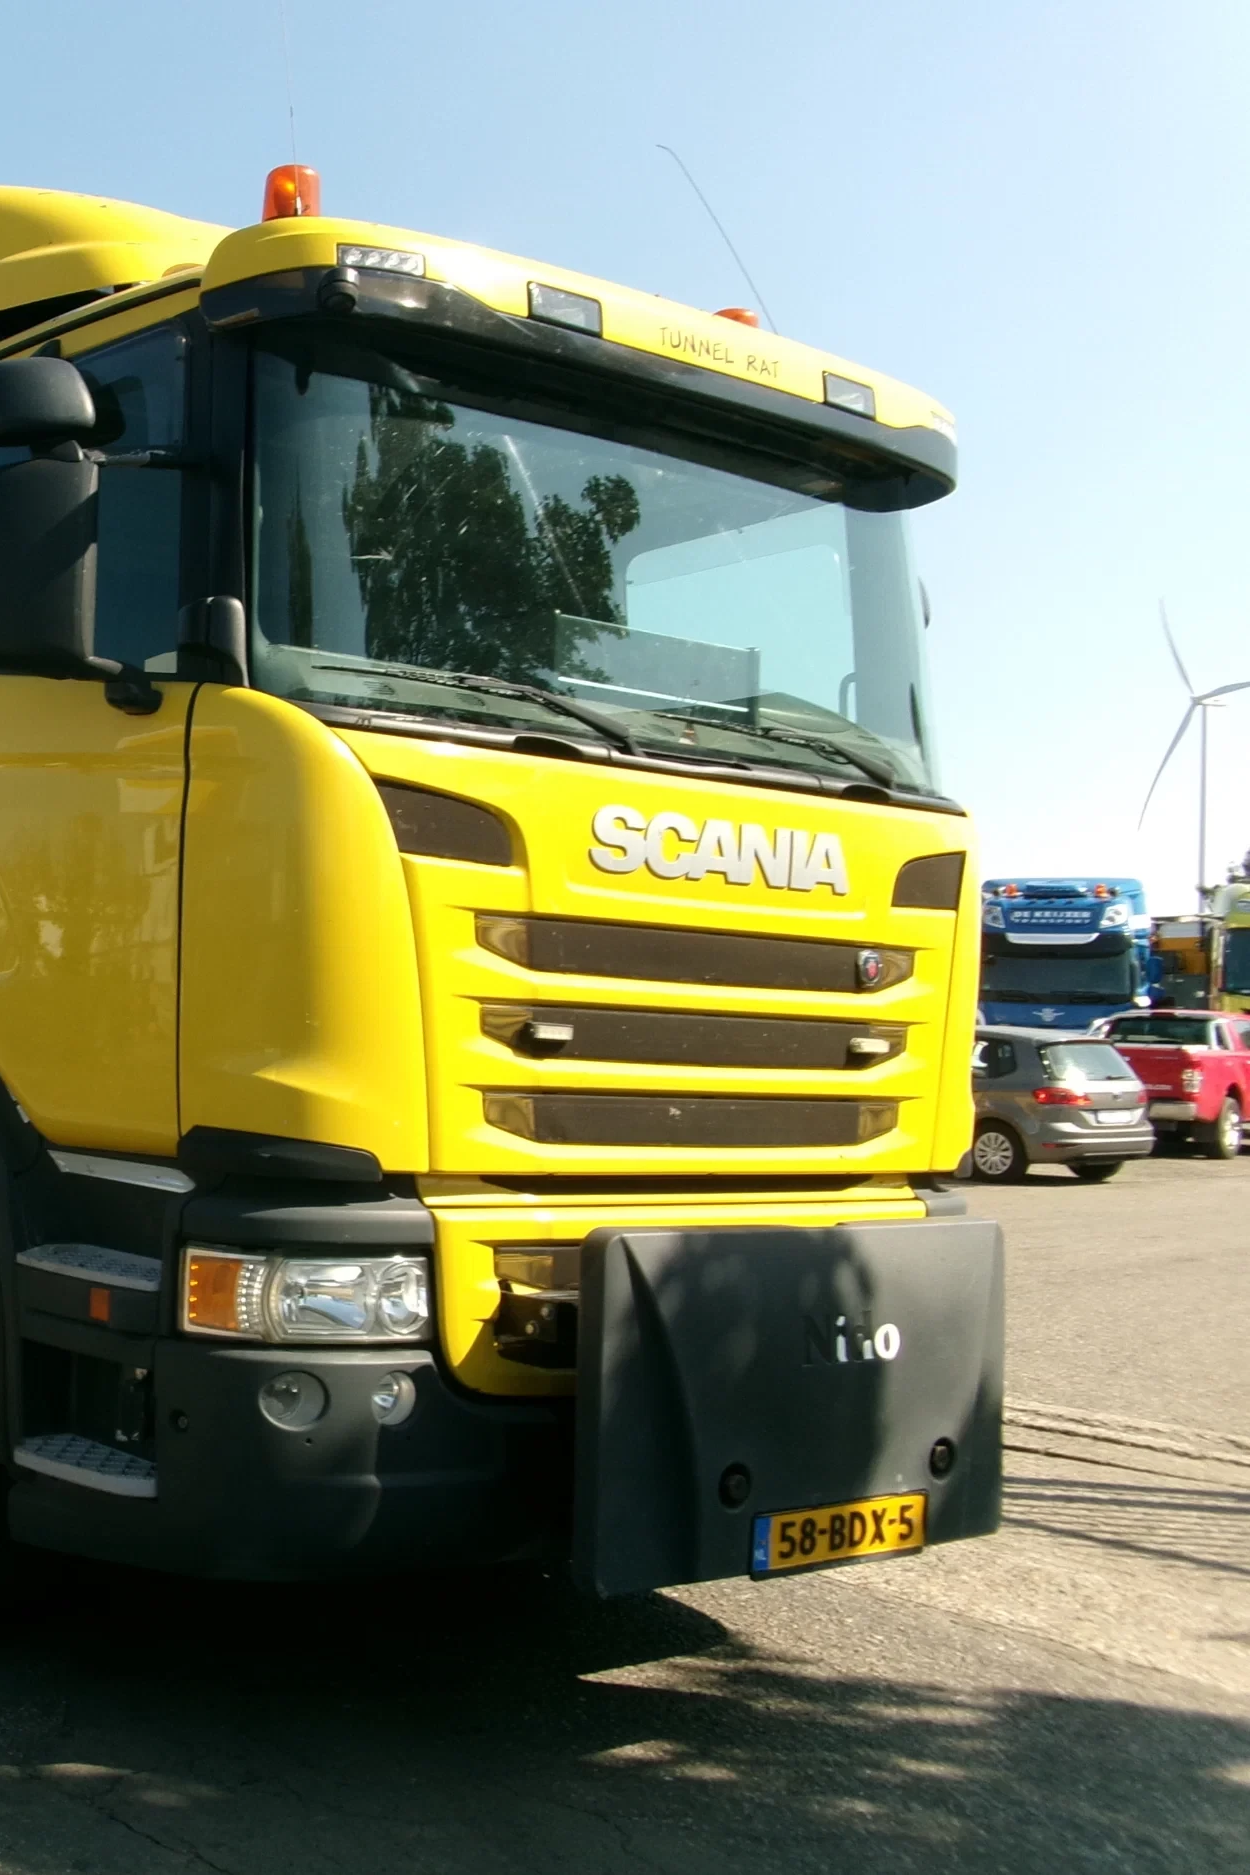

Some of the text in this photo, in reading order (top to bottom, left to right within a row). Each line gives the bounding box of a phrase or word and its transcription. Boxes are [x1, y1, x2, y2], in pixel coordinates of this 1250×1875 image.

[660, 327, 779, 378] TUNNEL RAT
[588, 804, 849, 897] SCANIA
[778, 1504, 915, 1560] 58-BDX-5
